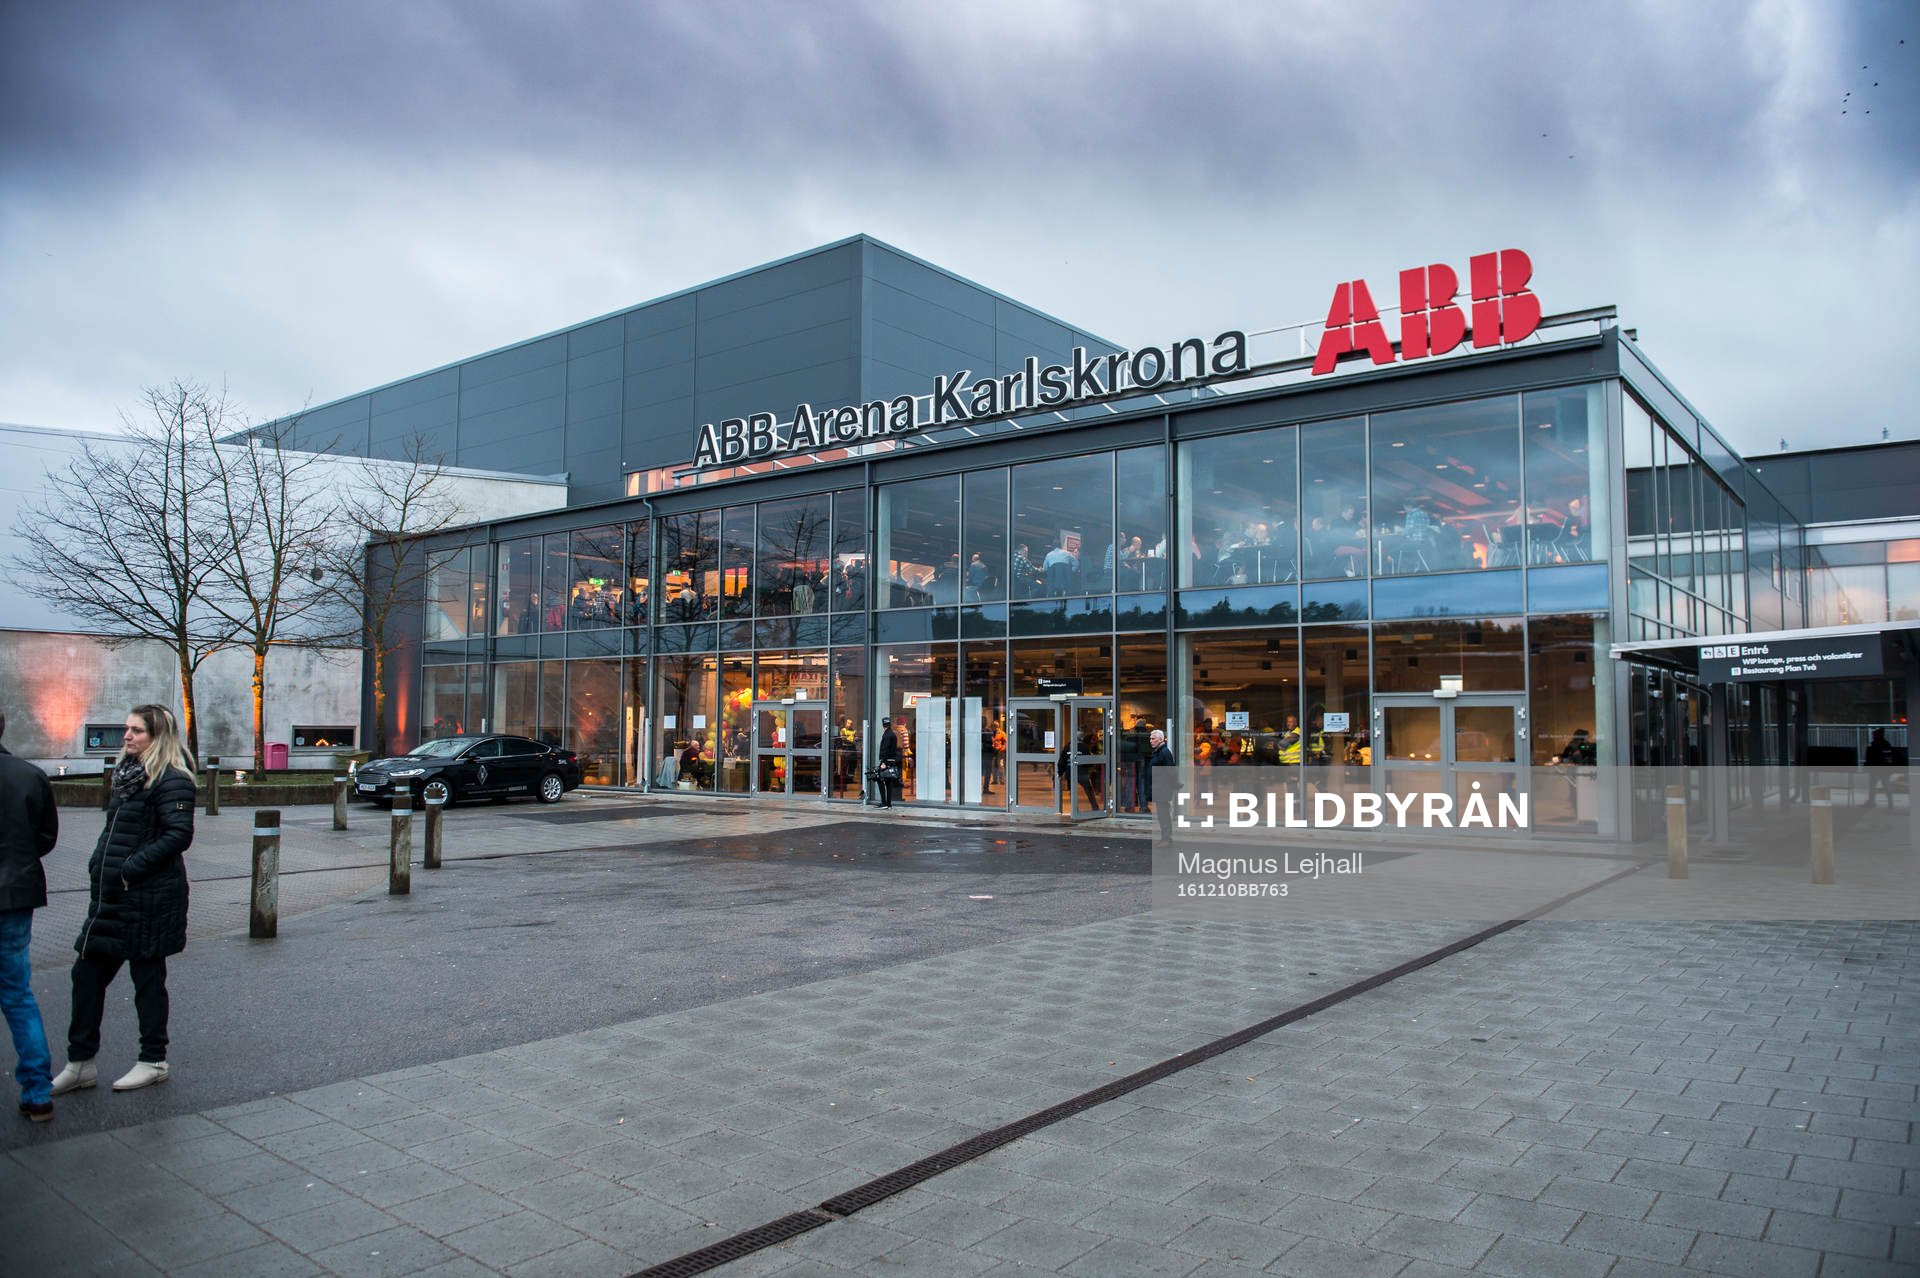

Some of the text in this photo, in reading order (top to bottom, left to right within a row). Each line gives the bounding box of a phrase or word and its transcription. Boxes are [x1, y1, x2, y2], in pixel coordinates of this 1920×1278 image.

[1311, 248, 1543, 376] ABB
[692, 329, 1250, 468] ABB Arena Karlskrona
[1741, 645, 1769, 656] Entré
[1786, 656, 1806, 664] press
[1785, 664, 1802, 672] Plan
[1802, 663, 1817, 672] Två
